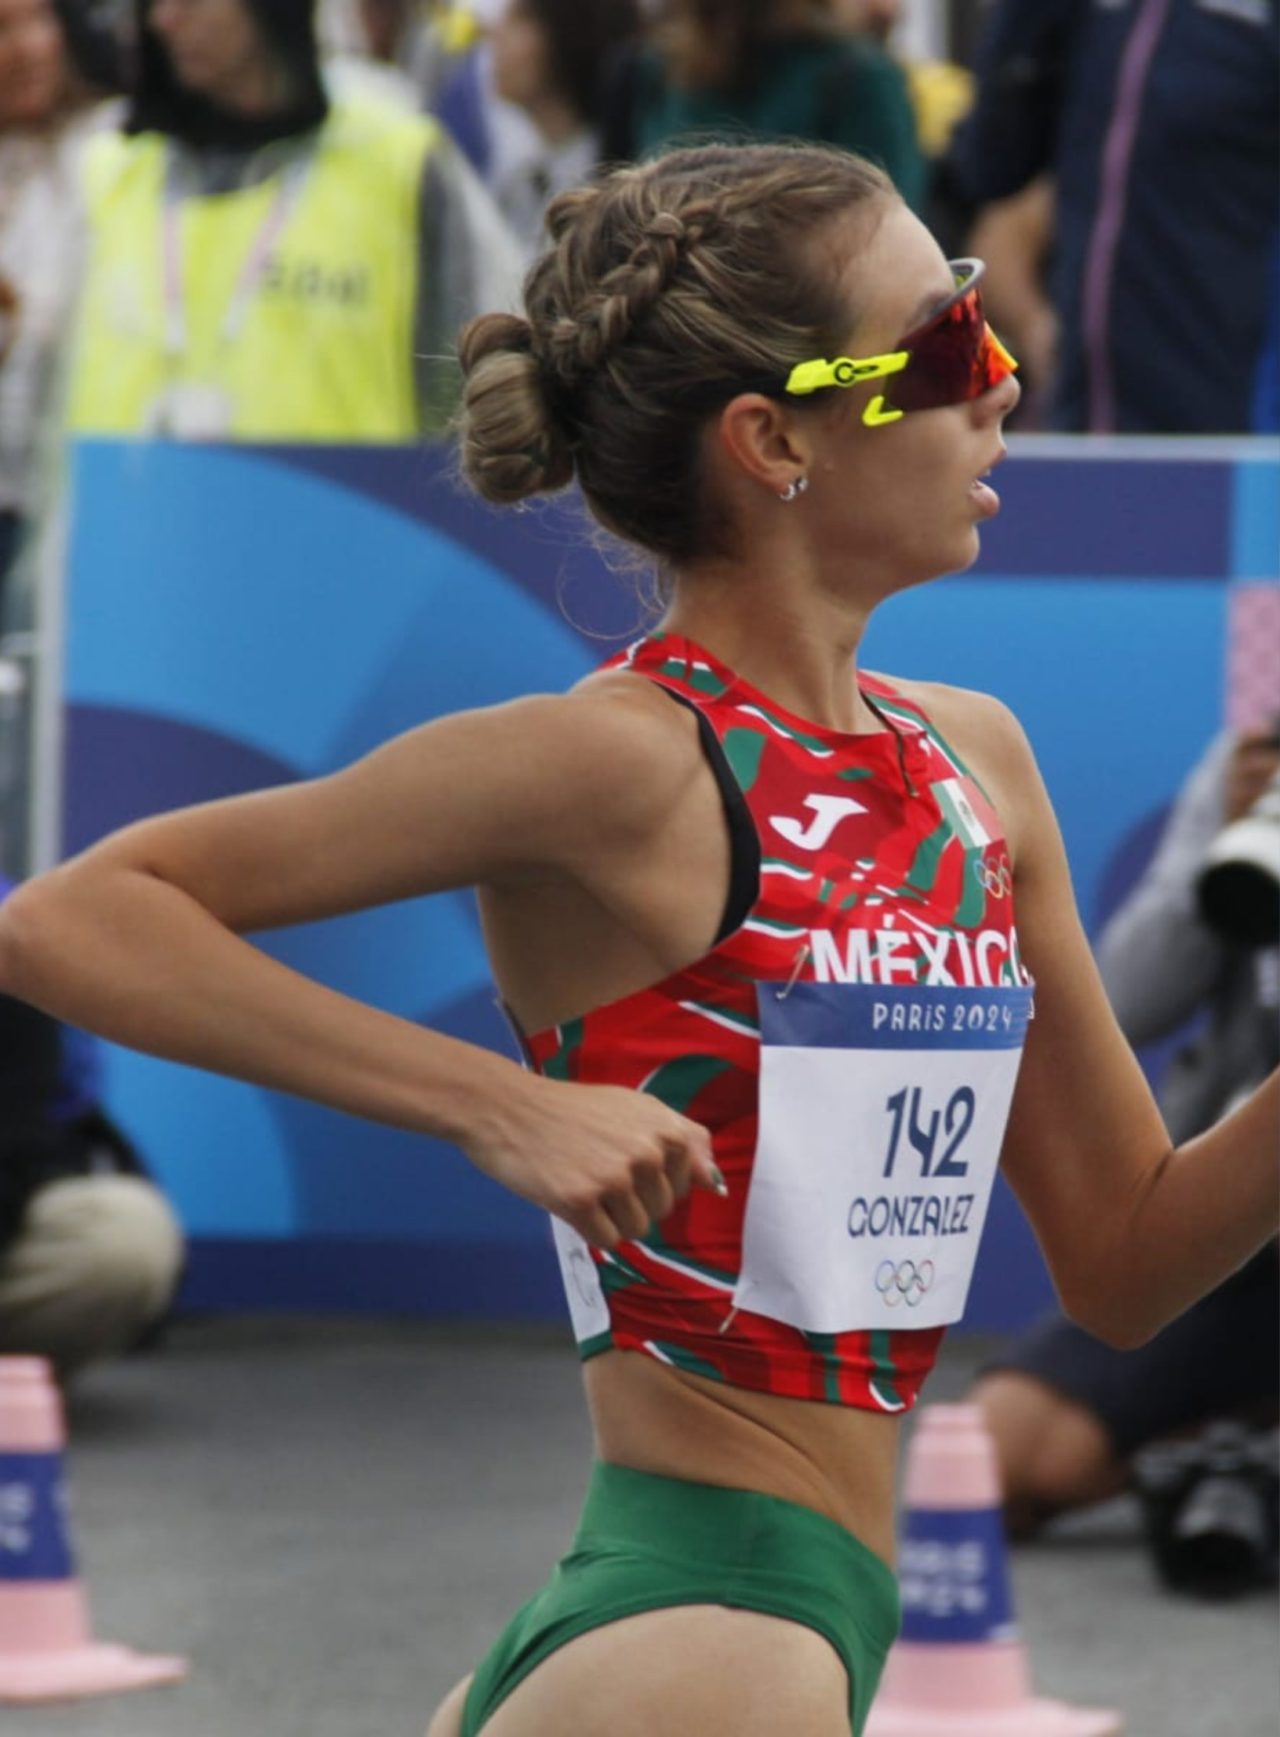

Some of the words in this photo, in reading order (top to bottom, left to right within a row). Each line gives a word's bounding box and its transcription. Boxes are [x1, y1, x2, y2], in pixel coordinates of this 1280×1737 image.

[952, 1004, 1012, 1032] 2024
[882, 1085, 976, 1178] 142
[848, 1194, 974, 1237] GONZALEZ
